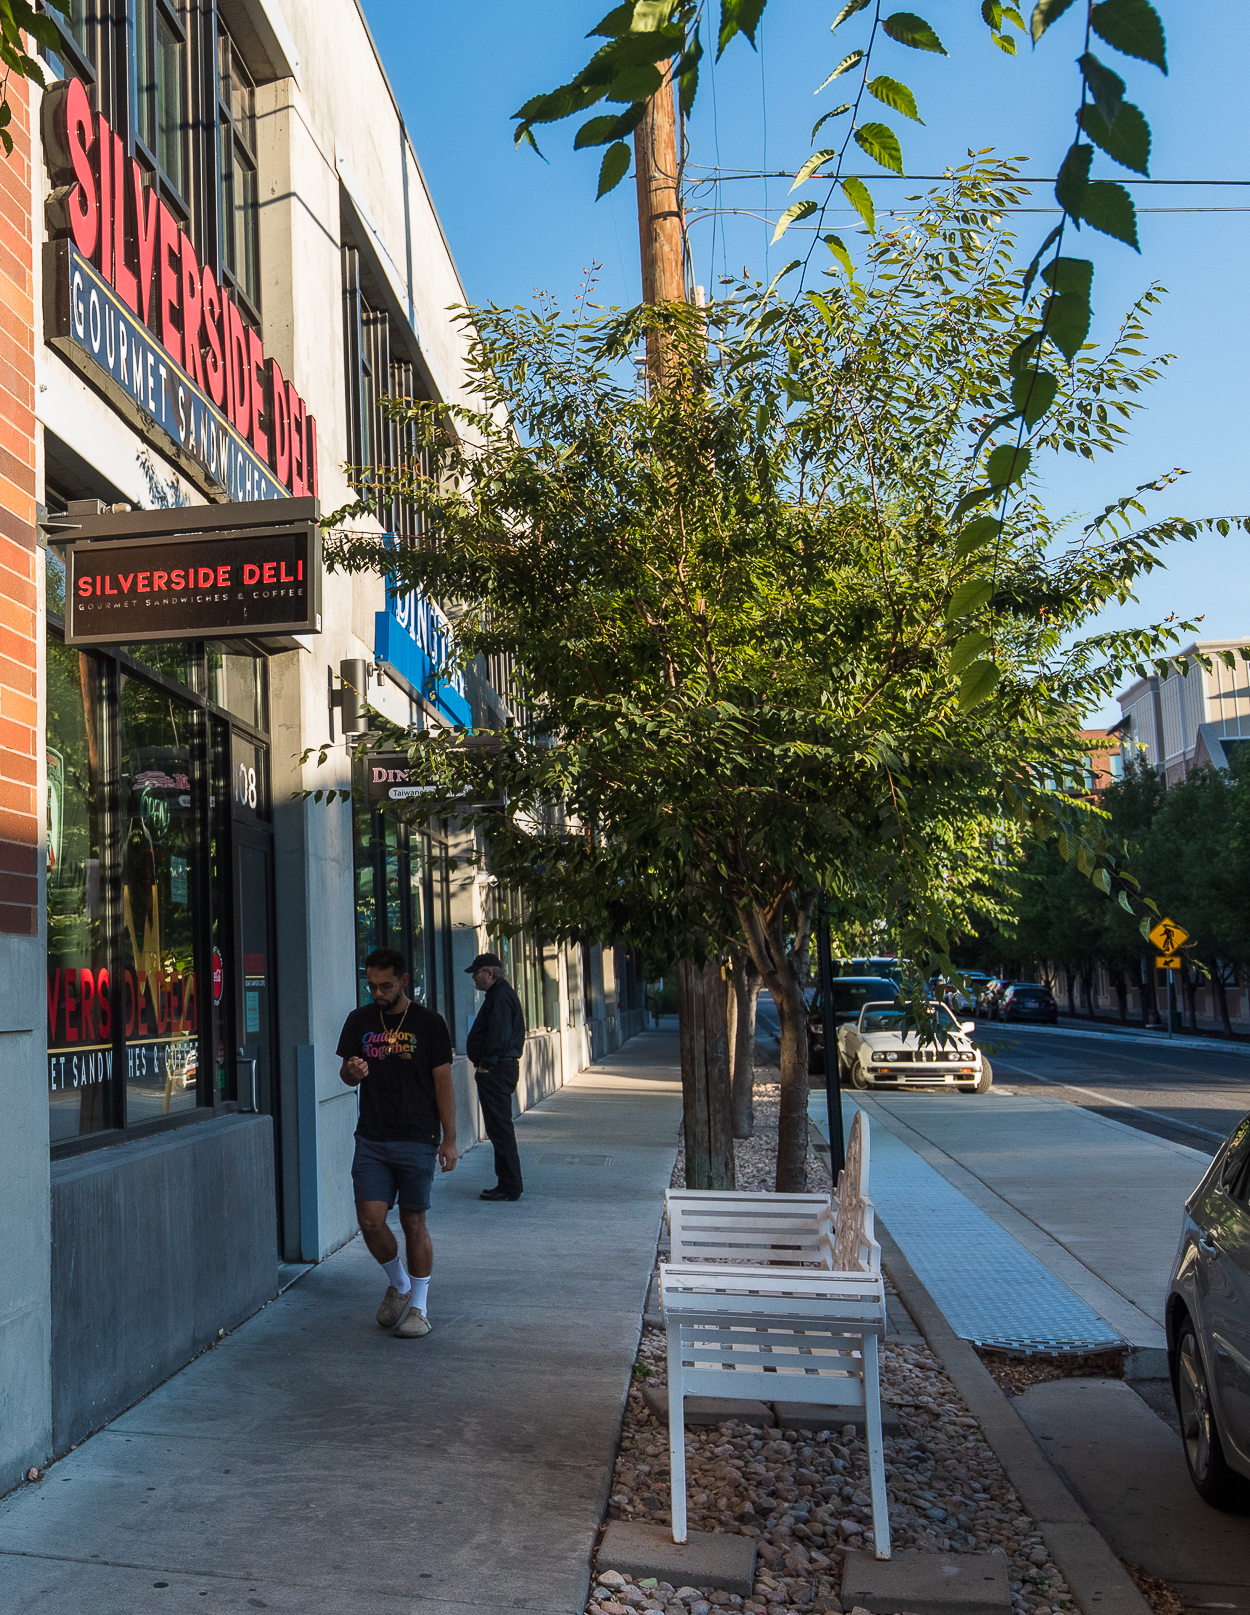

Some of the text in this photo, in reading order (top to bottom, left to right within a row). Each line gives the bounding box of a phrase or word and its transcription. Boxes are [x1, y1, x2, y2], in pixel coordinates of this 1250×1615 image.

[67, 77, 318, 498] SILVERSIDE DELI
[72, 270, 168, 423] GOURMET
[78, 560, 303, 597] SILVERSIDE DELI
[78, 588, 303, 611] GOURMET SANDWICHES & COFFEE
[233, 761, 257, 809] 108
[156, 971, 198, 1034] DELI
[362, 1041, 417, 1060] Together
